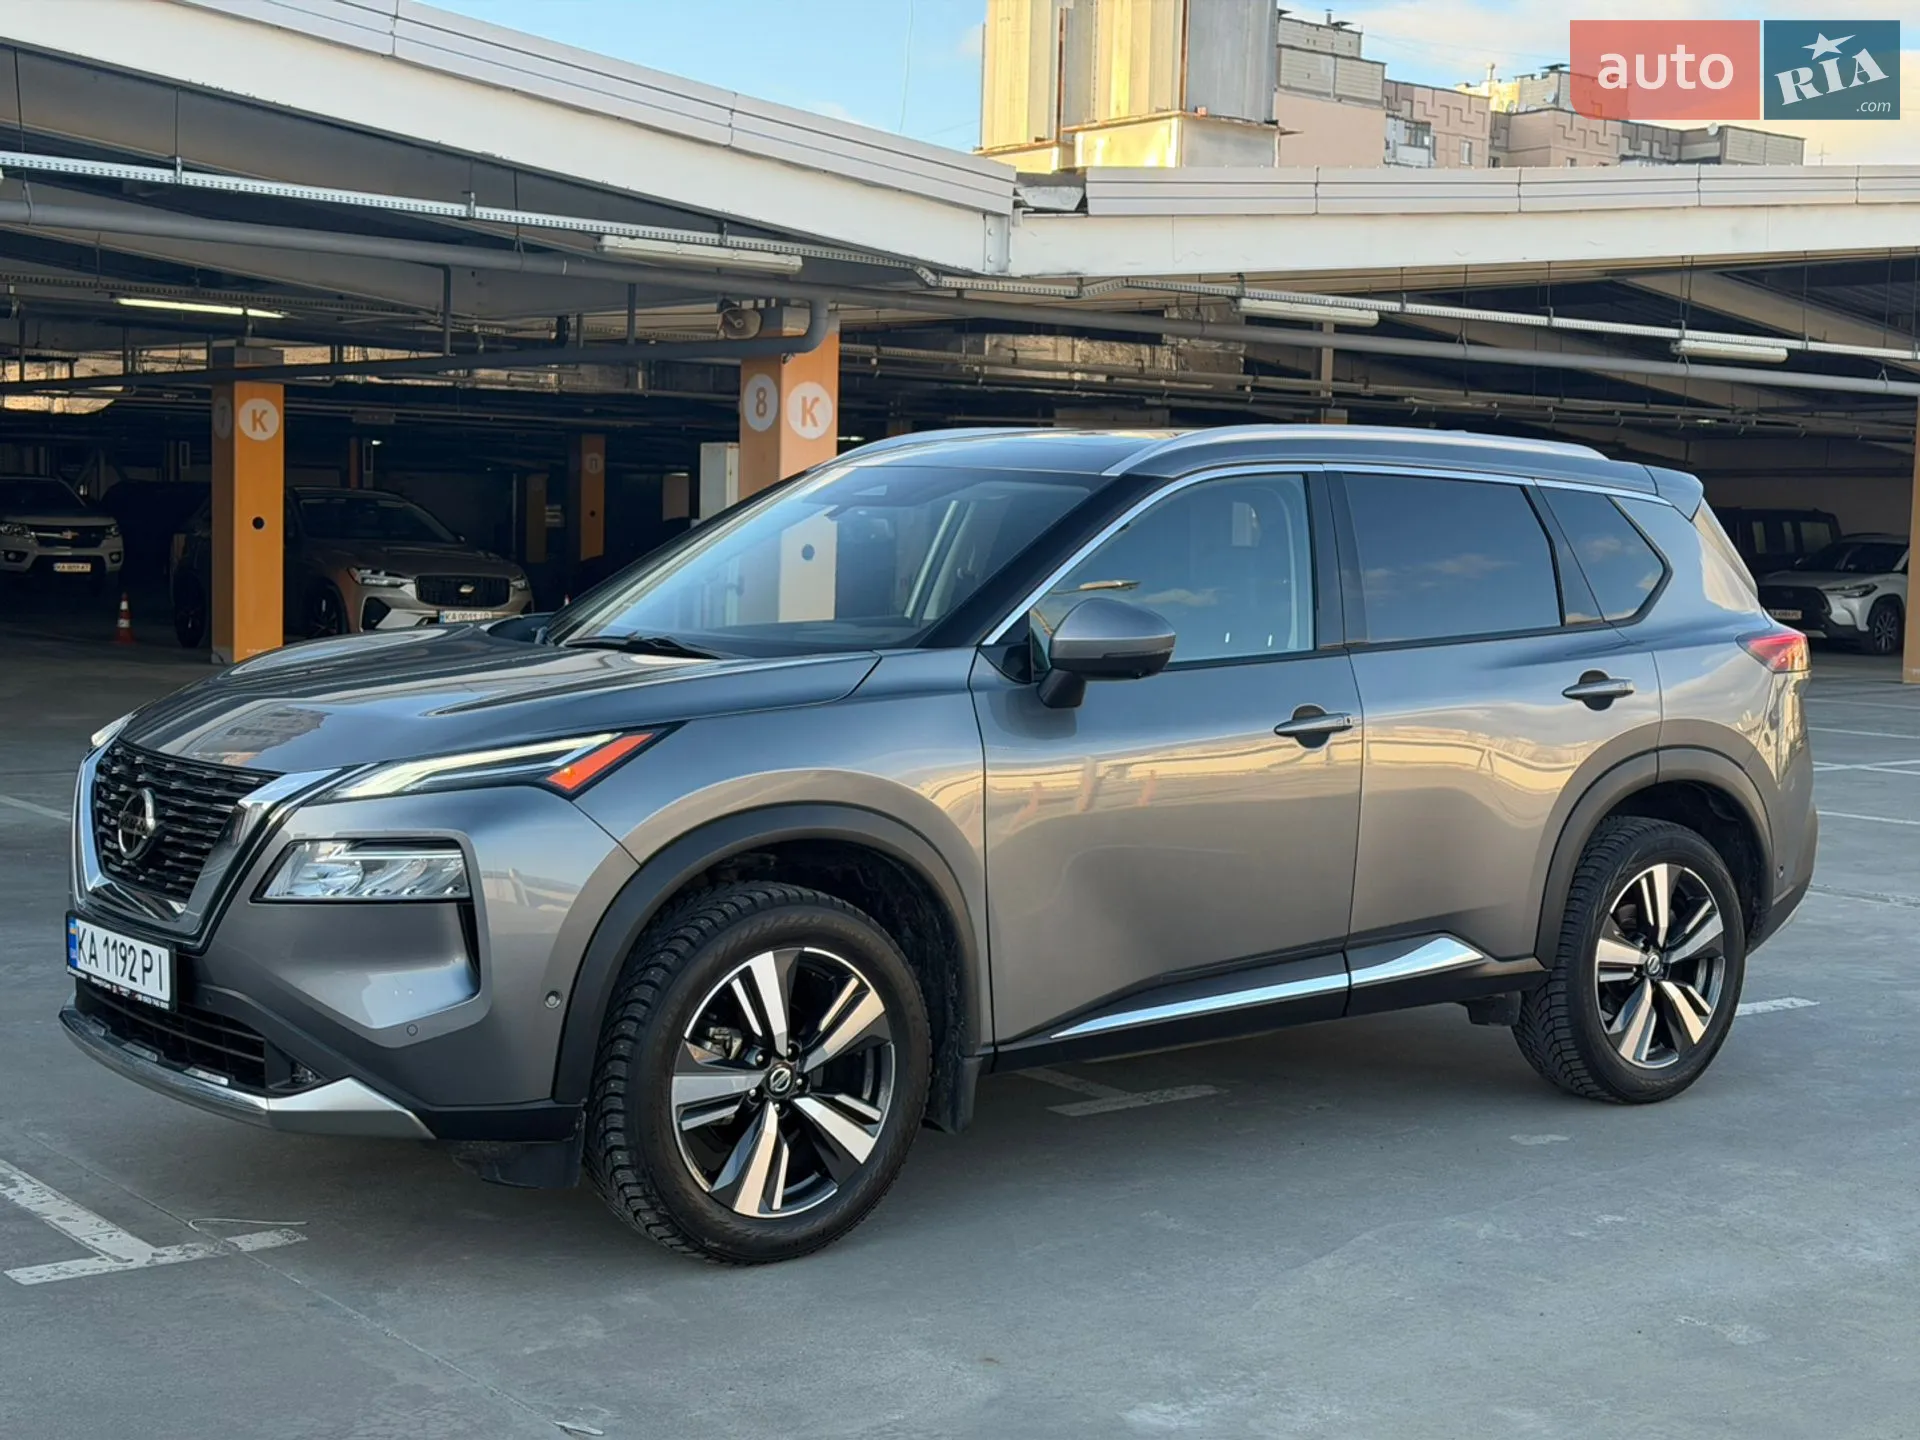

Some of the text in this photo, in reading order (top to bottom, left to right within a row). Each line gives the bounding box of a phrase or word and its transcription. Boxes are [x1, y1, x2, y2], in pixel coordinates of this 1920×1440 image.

[756, 387, 767, 418] 8
[77, 928, 98, 968] KA
[103, 936, 137, 983] 1192
